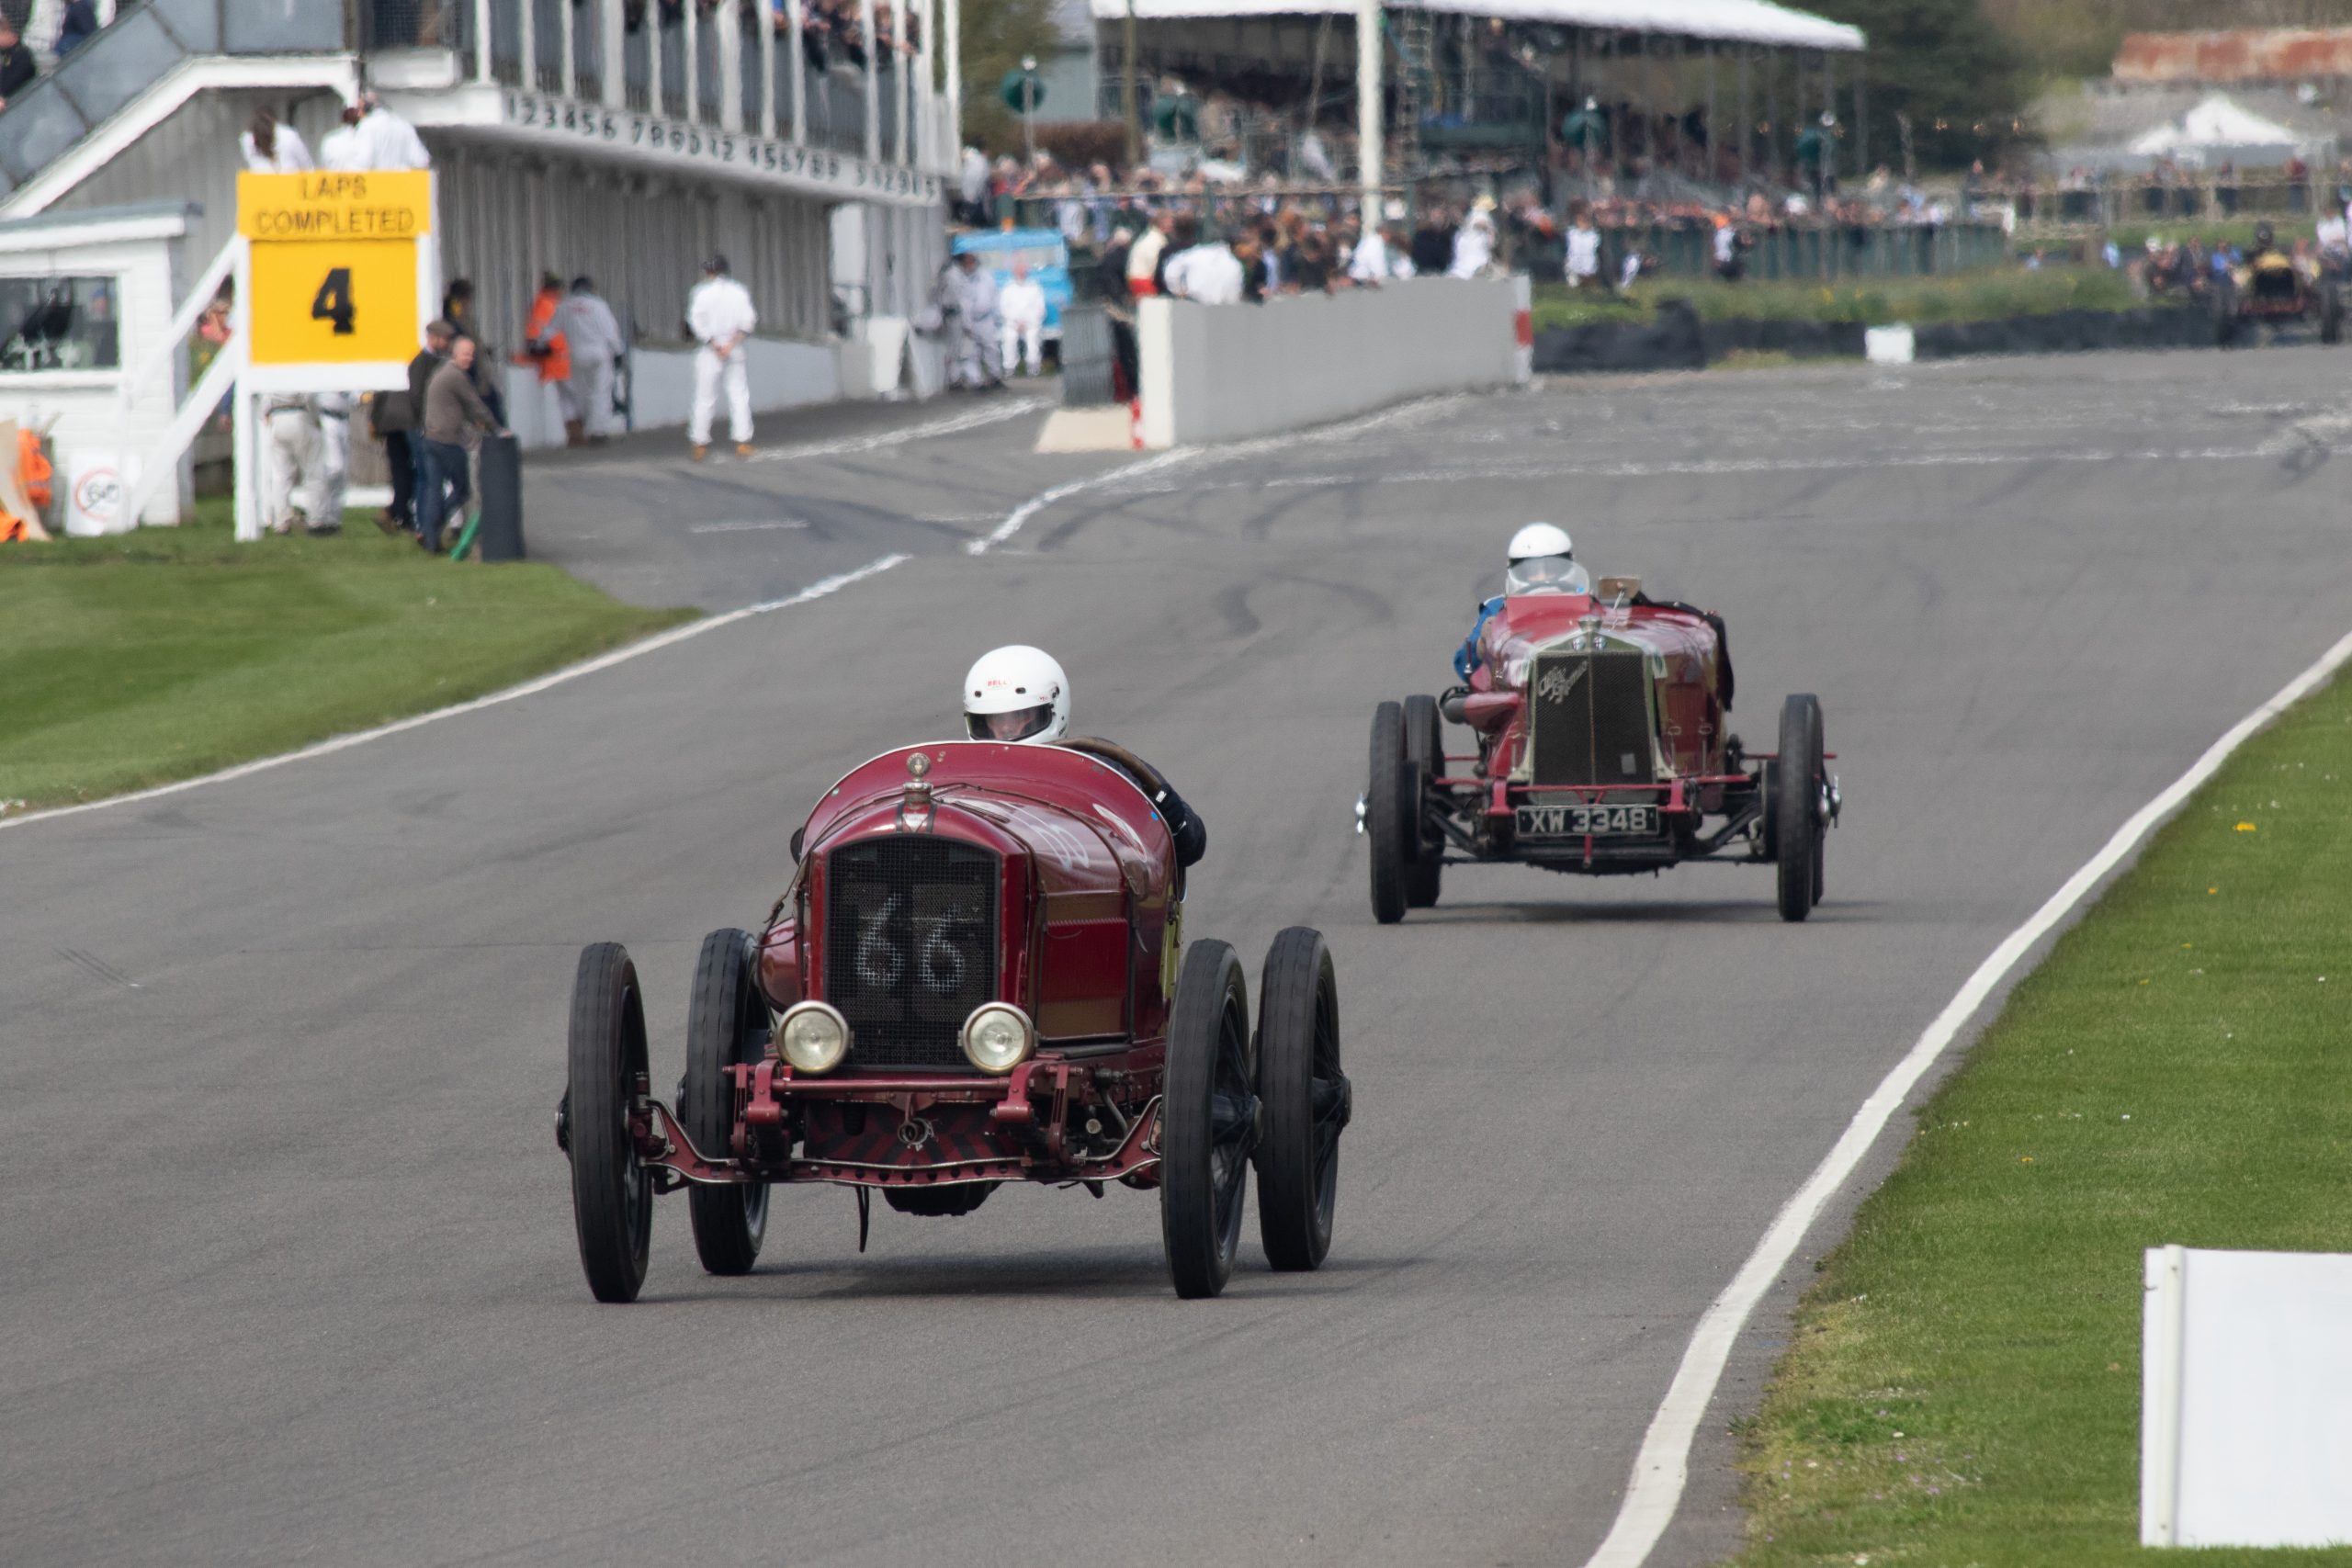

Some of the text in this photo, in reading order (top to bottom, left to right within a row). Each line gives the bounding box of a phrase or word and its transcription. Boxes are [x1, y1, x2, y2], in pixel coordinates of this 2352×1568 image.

[301, 175, 367, 201] LAPS
[255, 209, 415, 235] COMPLETED
[311, 267, 356, 336] 4
[1529, 808, 1646, 833] XW 3348
[854, 891, 965, 994] 66
